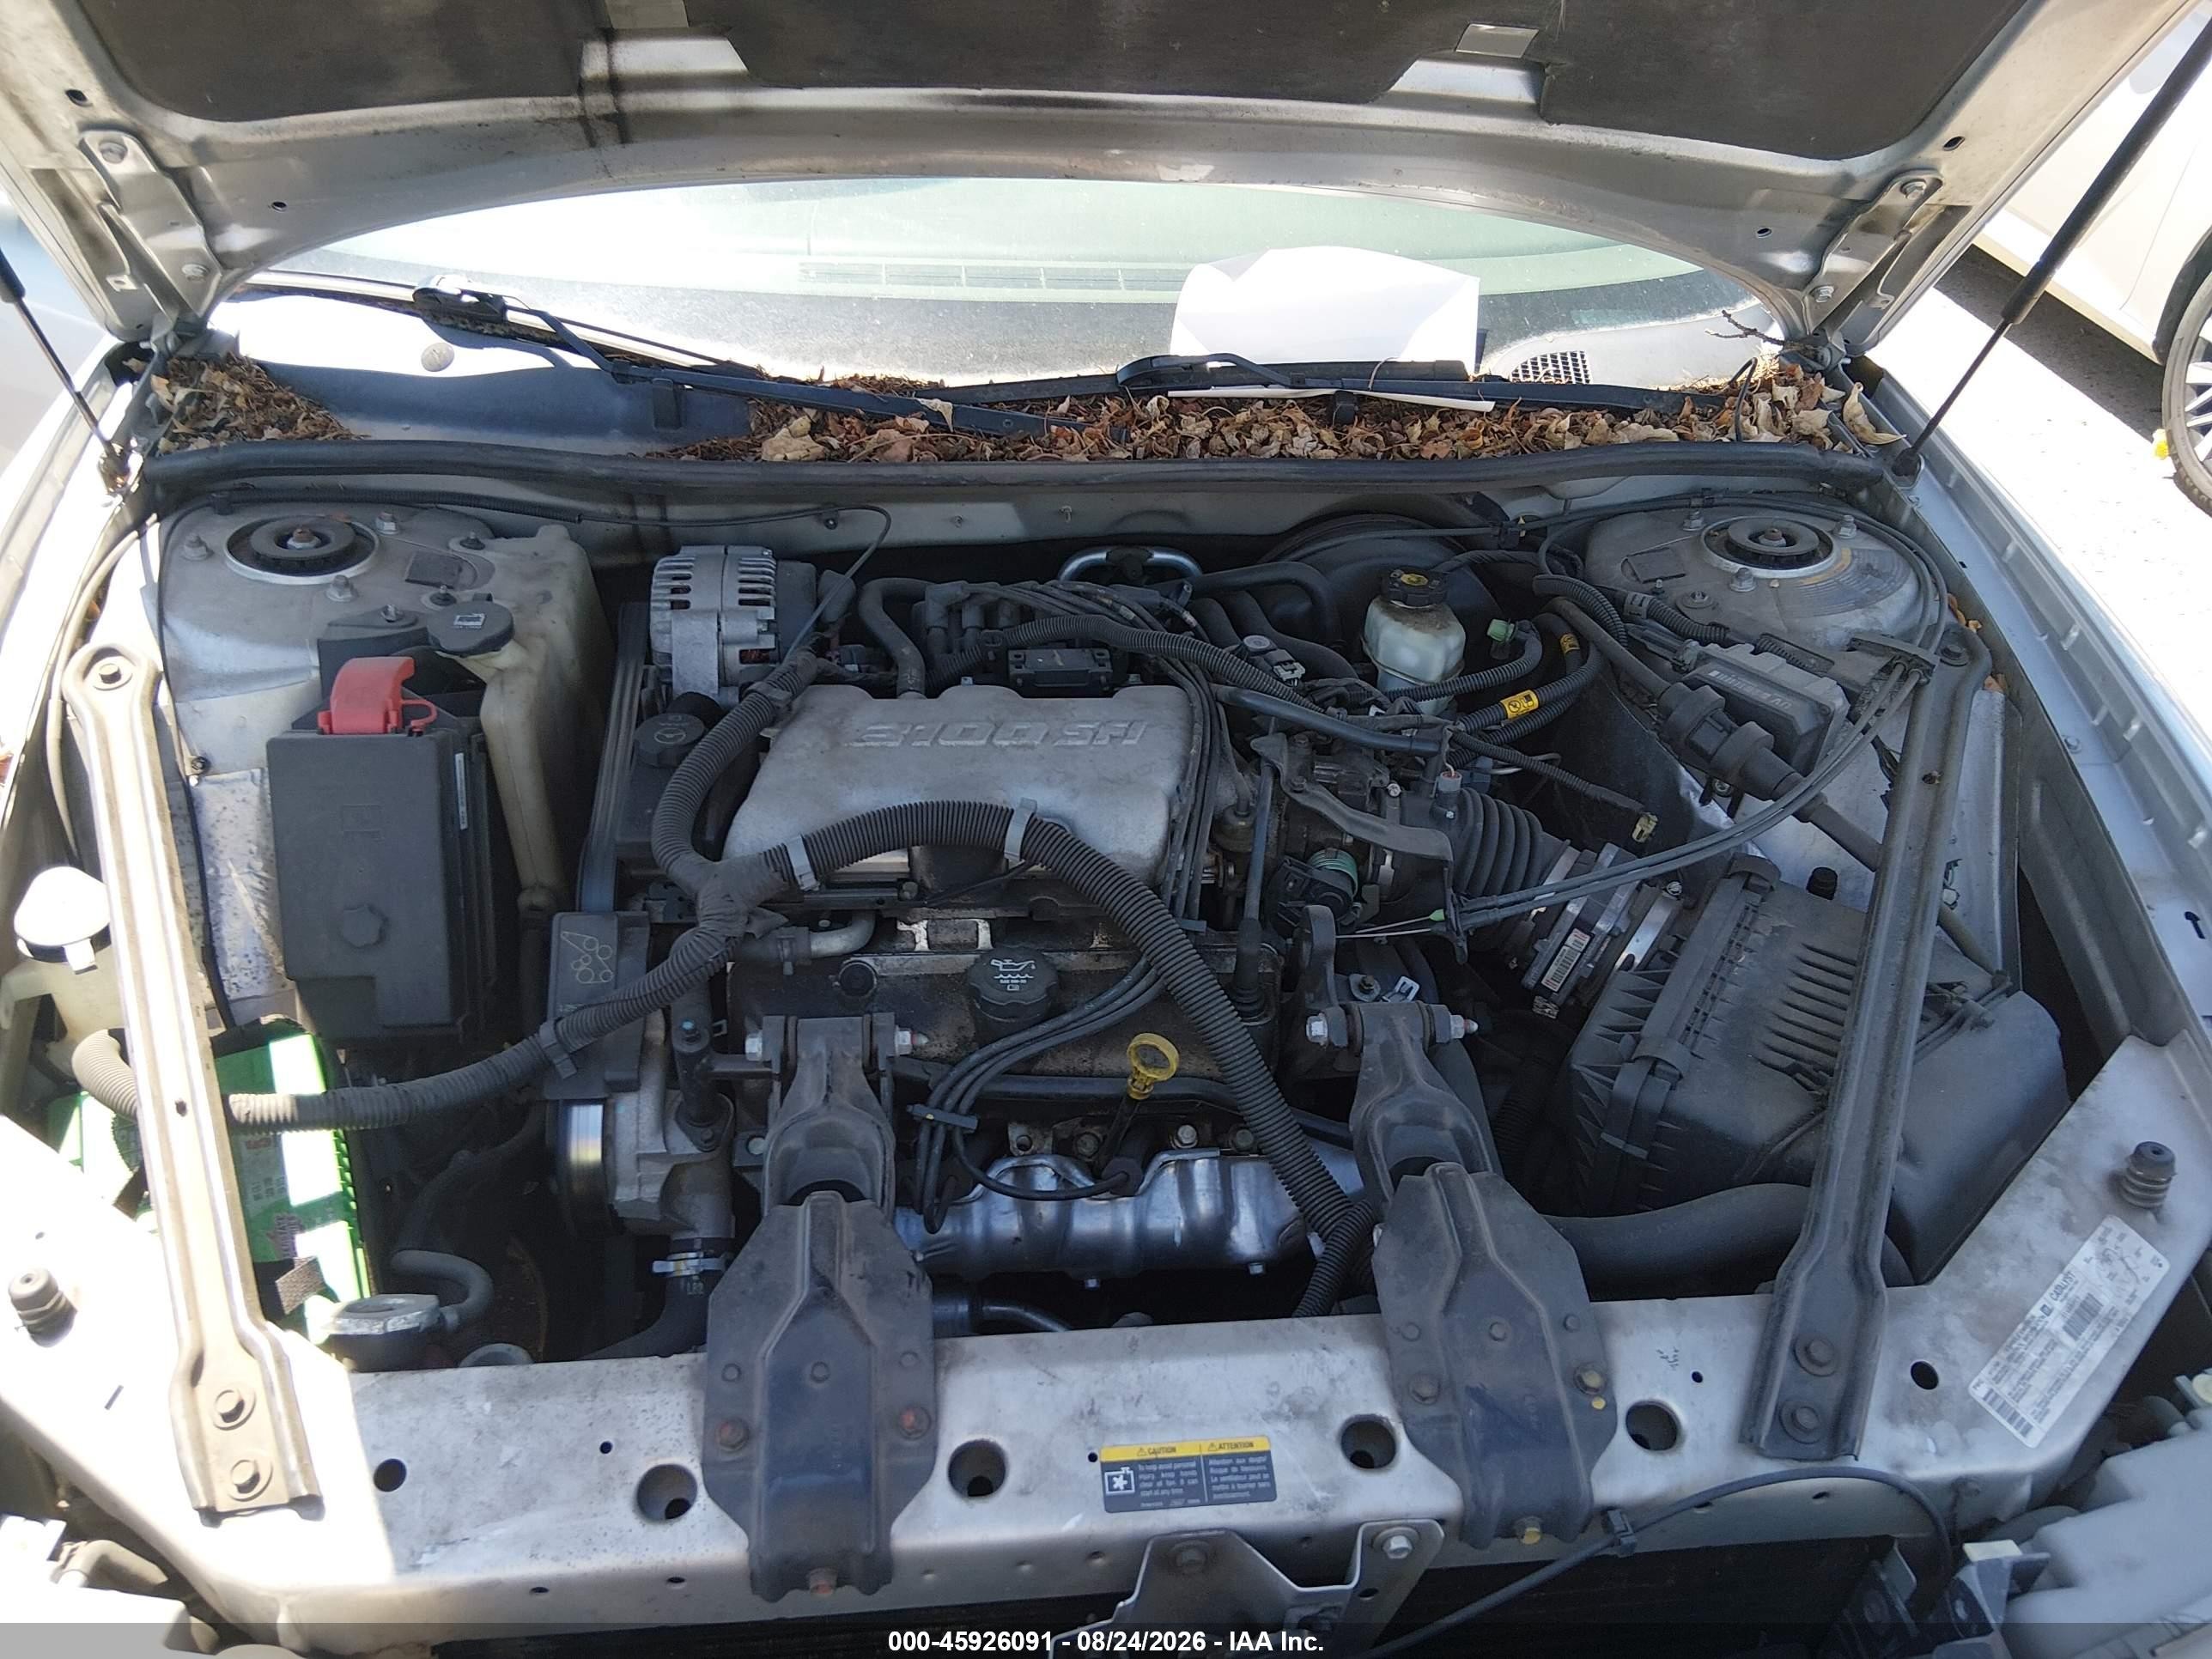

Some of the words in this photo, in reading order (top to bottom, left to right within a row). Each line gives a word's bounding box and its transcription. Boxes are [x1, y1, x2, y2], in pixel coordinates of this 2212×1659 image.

[847, 721, 1048, 748] 3100
[1052, 720, 1149, 747] SFI
[1218, 1441, 1255, 1450] ATTENTION
[1147, 1447, 1176, 1455] CAUTION
